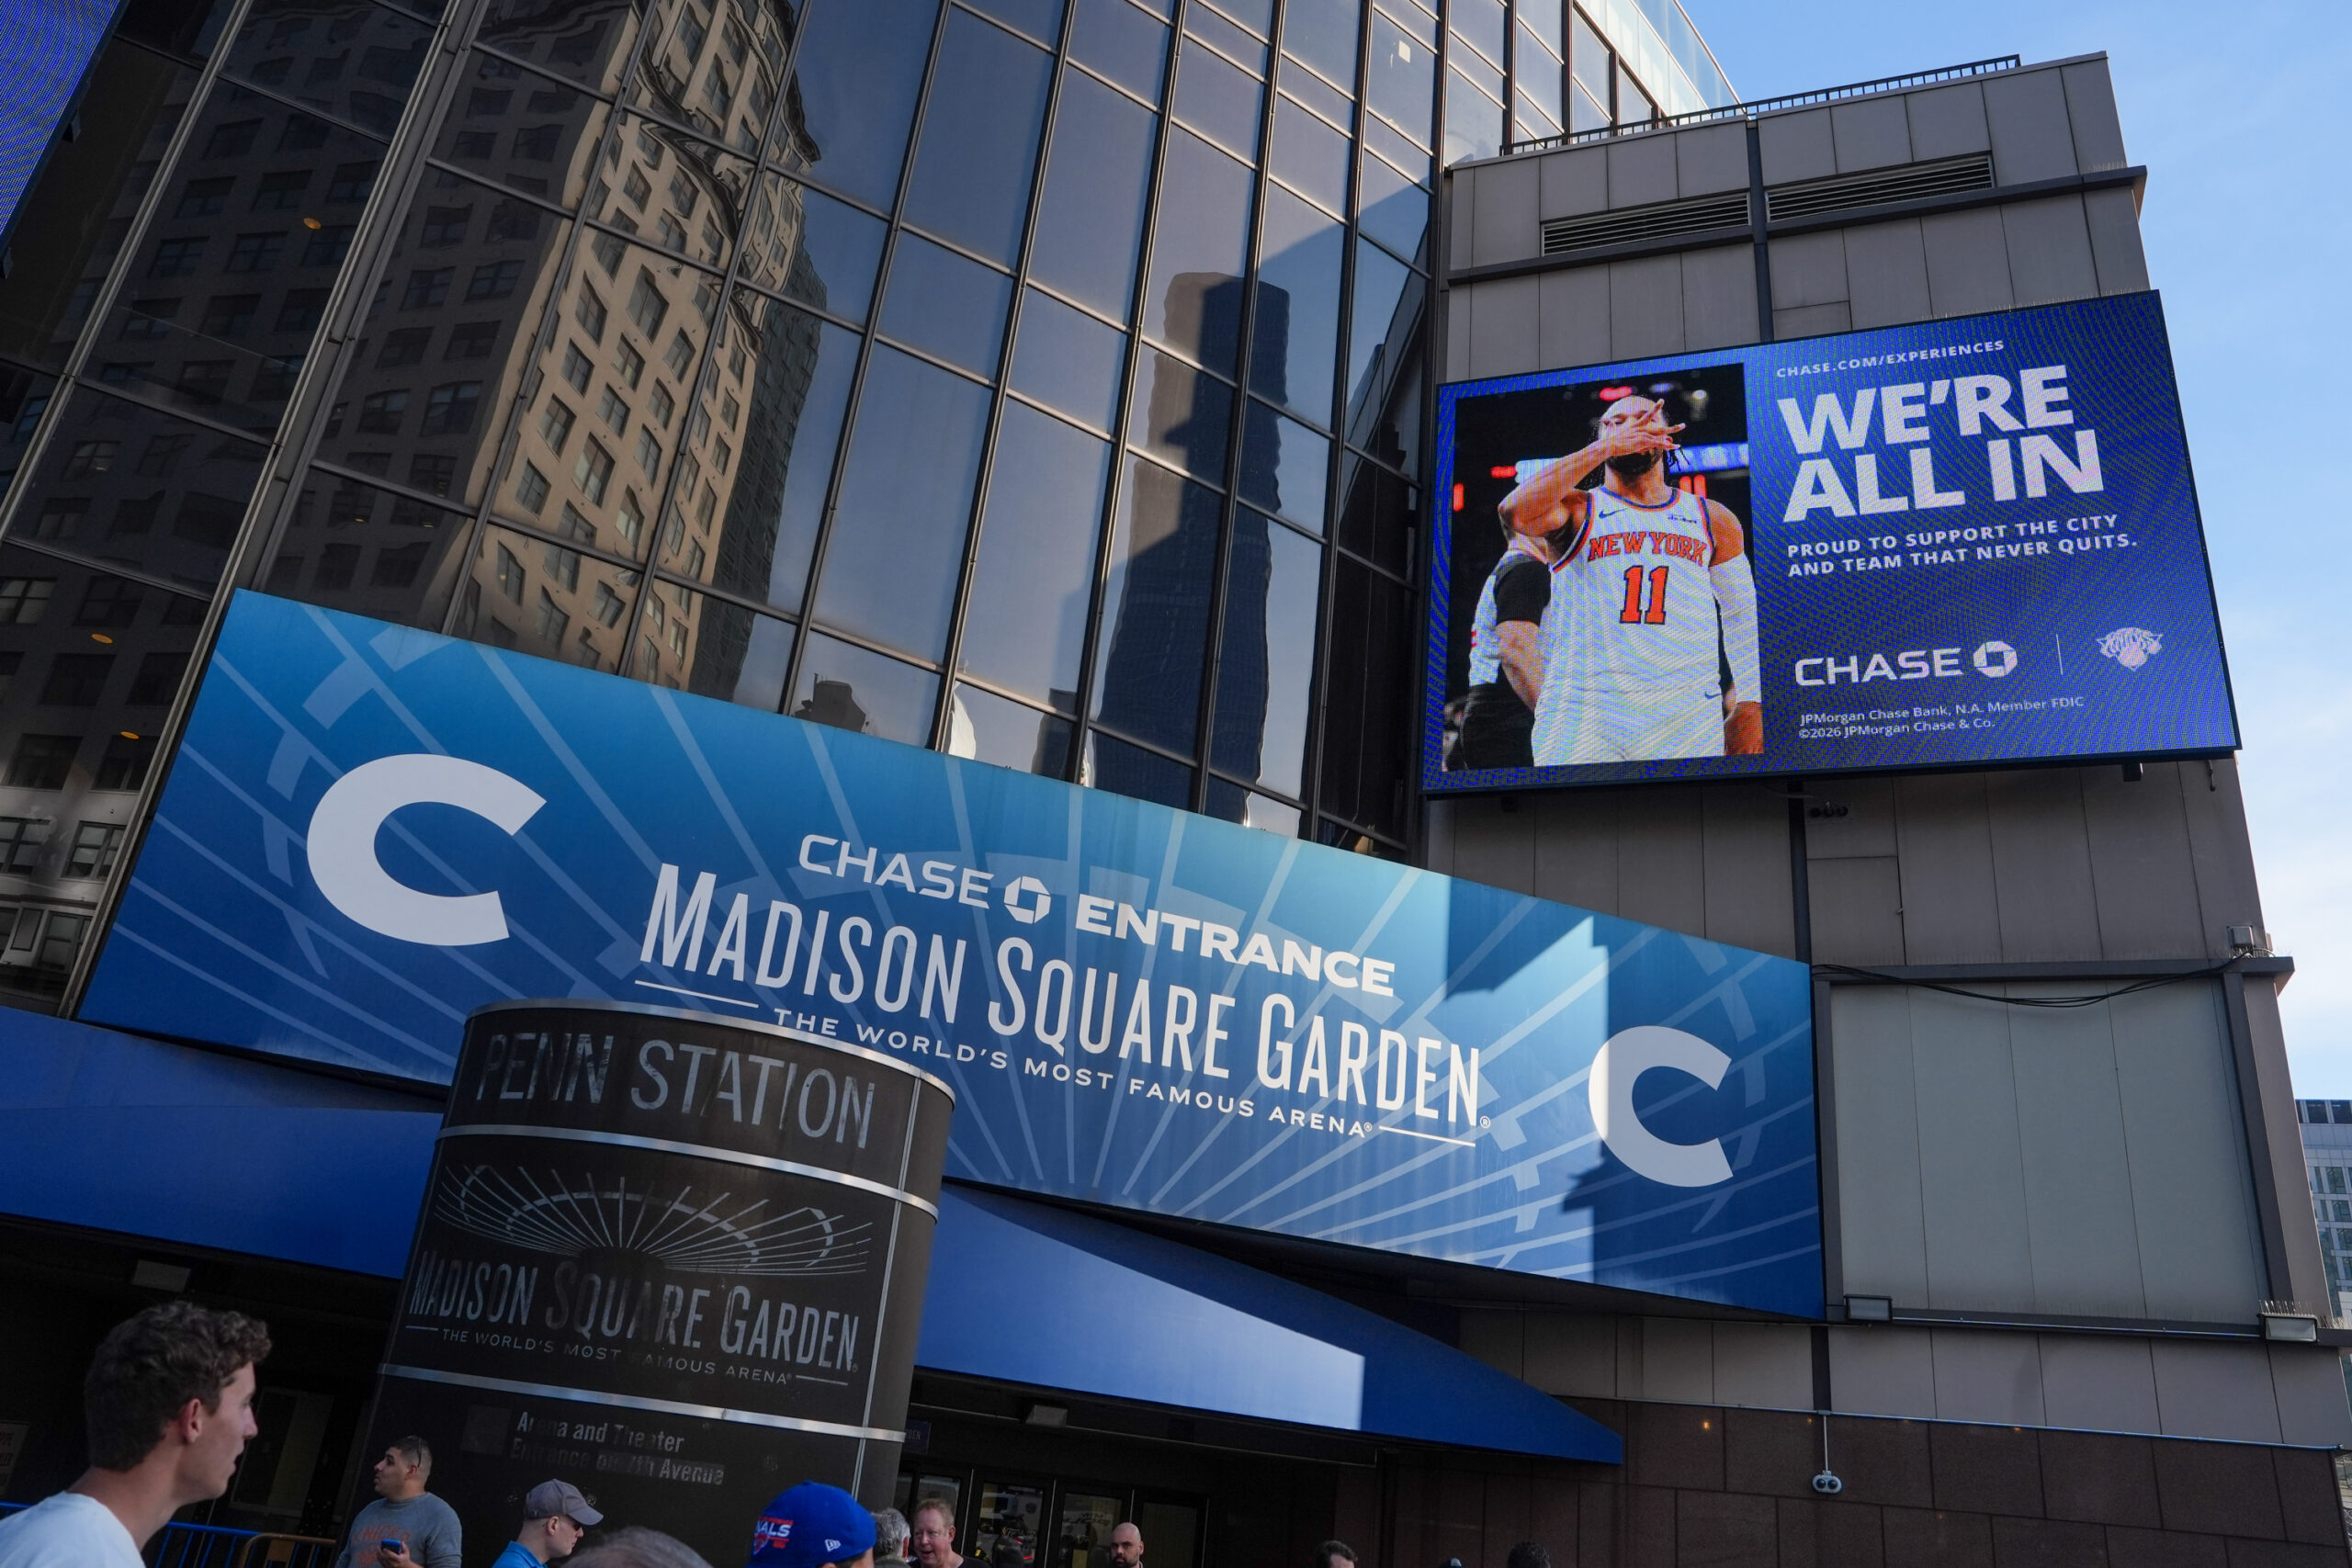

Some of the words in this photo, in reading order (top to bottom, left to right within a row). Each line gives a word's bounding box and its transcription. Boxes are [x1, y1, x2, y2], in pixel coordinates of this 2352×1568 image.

[1777, 340, 2004, 378] CHASE.COM/EXPERIENCES
[1783, 447, 1965, 523] ALL
[1987, 429, 2104, 502] IN
[1589, 532, 1647, 562] NEW
[1648, 531, 1707, 564] YORK
[1788, 539, 1860, 558] PROUD
[1869, 535, 1897, 550] TO
[1905, 525, 2007, 547] SUPPORT
[2015, 519, 2058, 537] THE
[2066, 513, 2118, 533] CITY
[1788, 559, 1834, 577] AND
[1842, 553, 1902, 572] TEAM
[1912, 547, 1968, 566] THAT
[1976, 540, 2050, 560] NEVER
[2058, 533, 2138, 555] QUITS.
[1620, 565, 1669, 625] 11
[1795, 648, 1964, 686] CHASE
[1800, 710, 1865, 727] JPMorgan
[1869, 706, 1910, 720] Chase
[1913, 704, 1952, 718] Bank,
[1956, 701, 1984, 714] N.A.
[1988, 697, 2048, 712] Member
[2052, 696, 2085, 708] FDIC
[1844, 722, 1910, 739] JPMorgan
[1914, 719, 1955, 732] Chase
[1959, 718, 1970, 729] &
[1973, 716, 1996, 728] Co.
[307, 754, 547, 946] C
[798, 834, 995, 909] CHASE
[1076, 893, 1396, 998] ENTRANCE
[640, 863, 967, 1024] MADISON
[988, 937, 1236, 1079] SQUARE
[774, 1008, 840, 1037] THE
[1024, 1057, 1114, 1089] MOST
[1129, 1078, 1254, 1118] FAMOUS
[476, 1032, 615, 1104] PENN
[630, 1039, 875, 1149] STATION
[1589, 1026, 1735, 1188] C
[408, 1252, 538, 1326] MADISON
[546, 1261, 711, 1350] SQUARE
[441, 1328, 469, 1343] THE
[562, 1344, 622, 1360] MOST
[572, 1423, 608, 1443] and
[659, 1458, 725, 1485] Avenue
